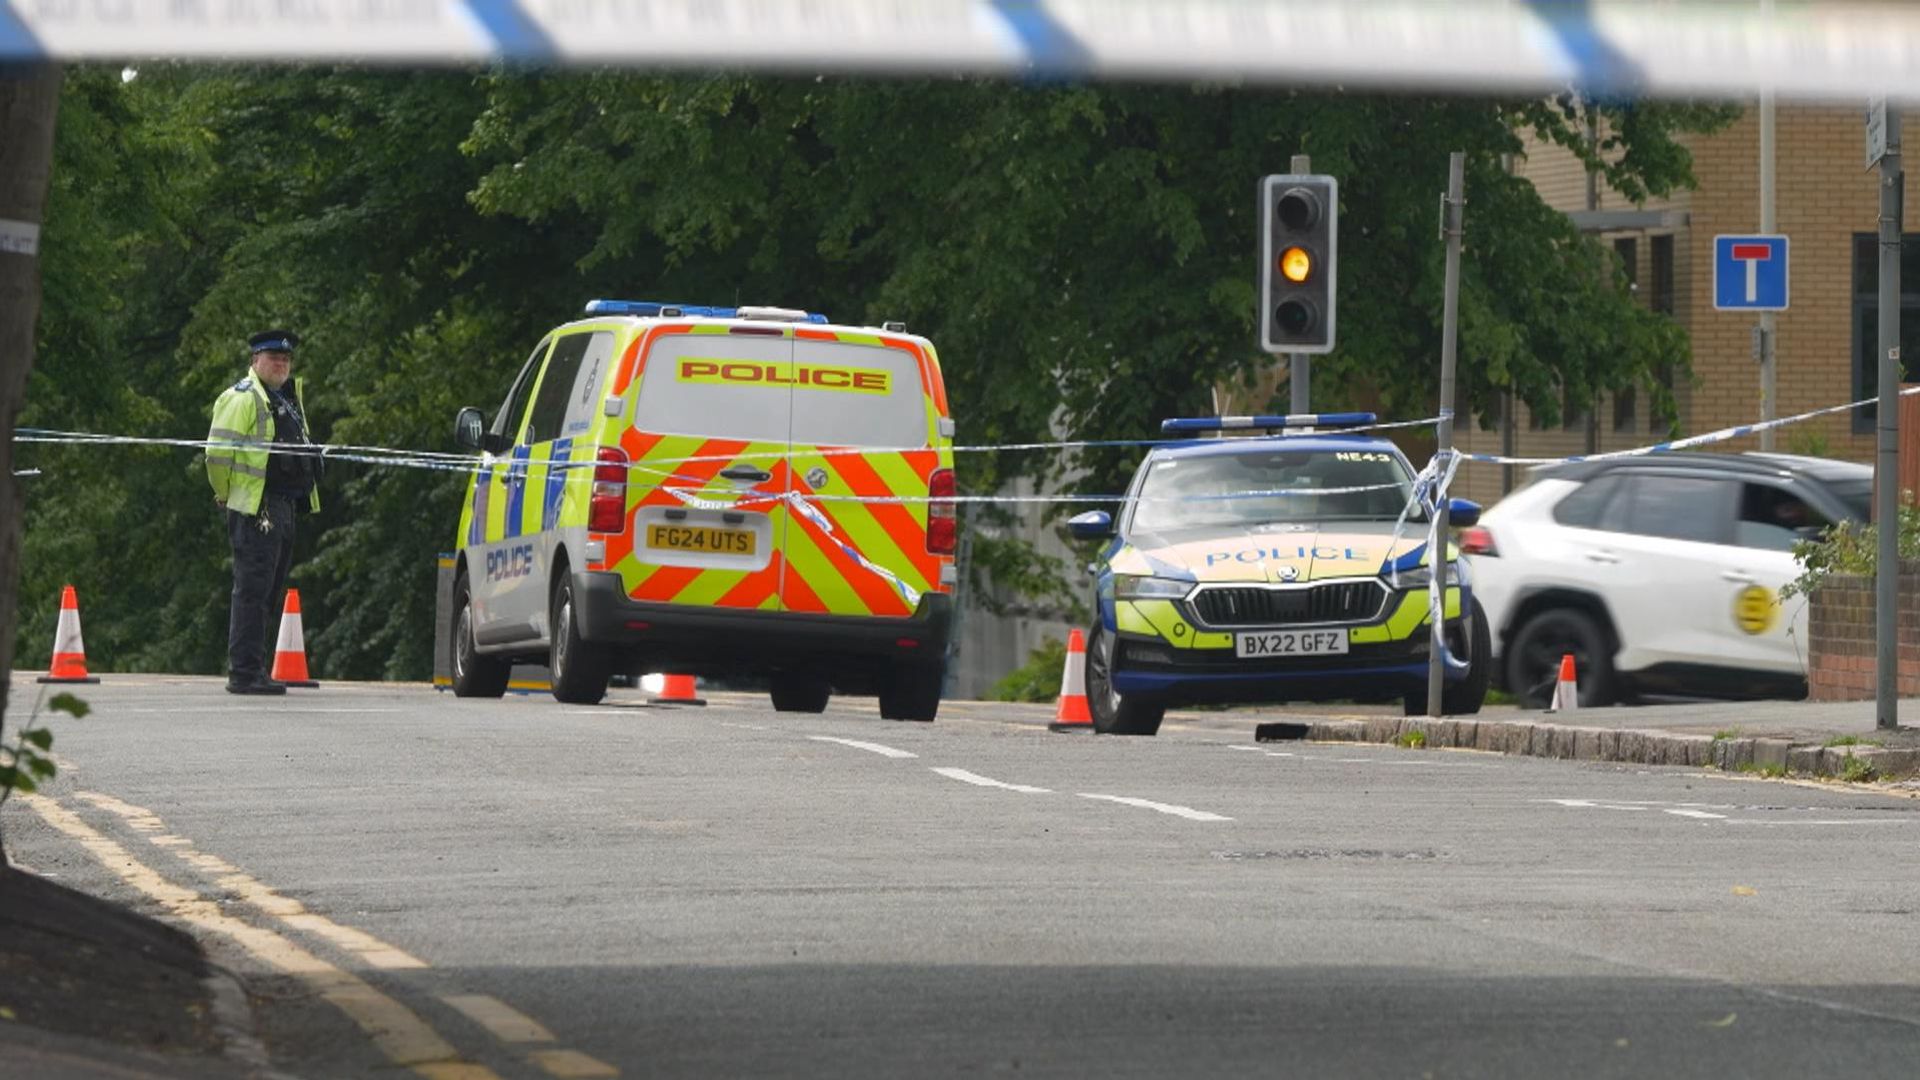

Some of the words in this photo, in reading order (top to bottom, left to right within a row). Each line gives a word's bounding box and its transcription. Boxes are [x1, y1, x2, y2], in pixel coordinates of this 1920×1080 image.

[681, 361, 887, 391] POLICE
[1335, 452, 1391, 462] NE43
[654, 527, 705, 547] FG24
[710, 532, 748, 552] UTS
[486, 544, 533, 583] POLICE
[1206, 547, 1370, 567] POLICE
[1244, 634, 1296, 654] BX22
[1301, 632, 1340, 652] GFZ
